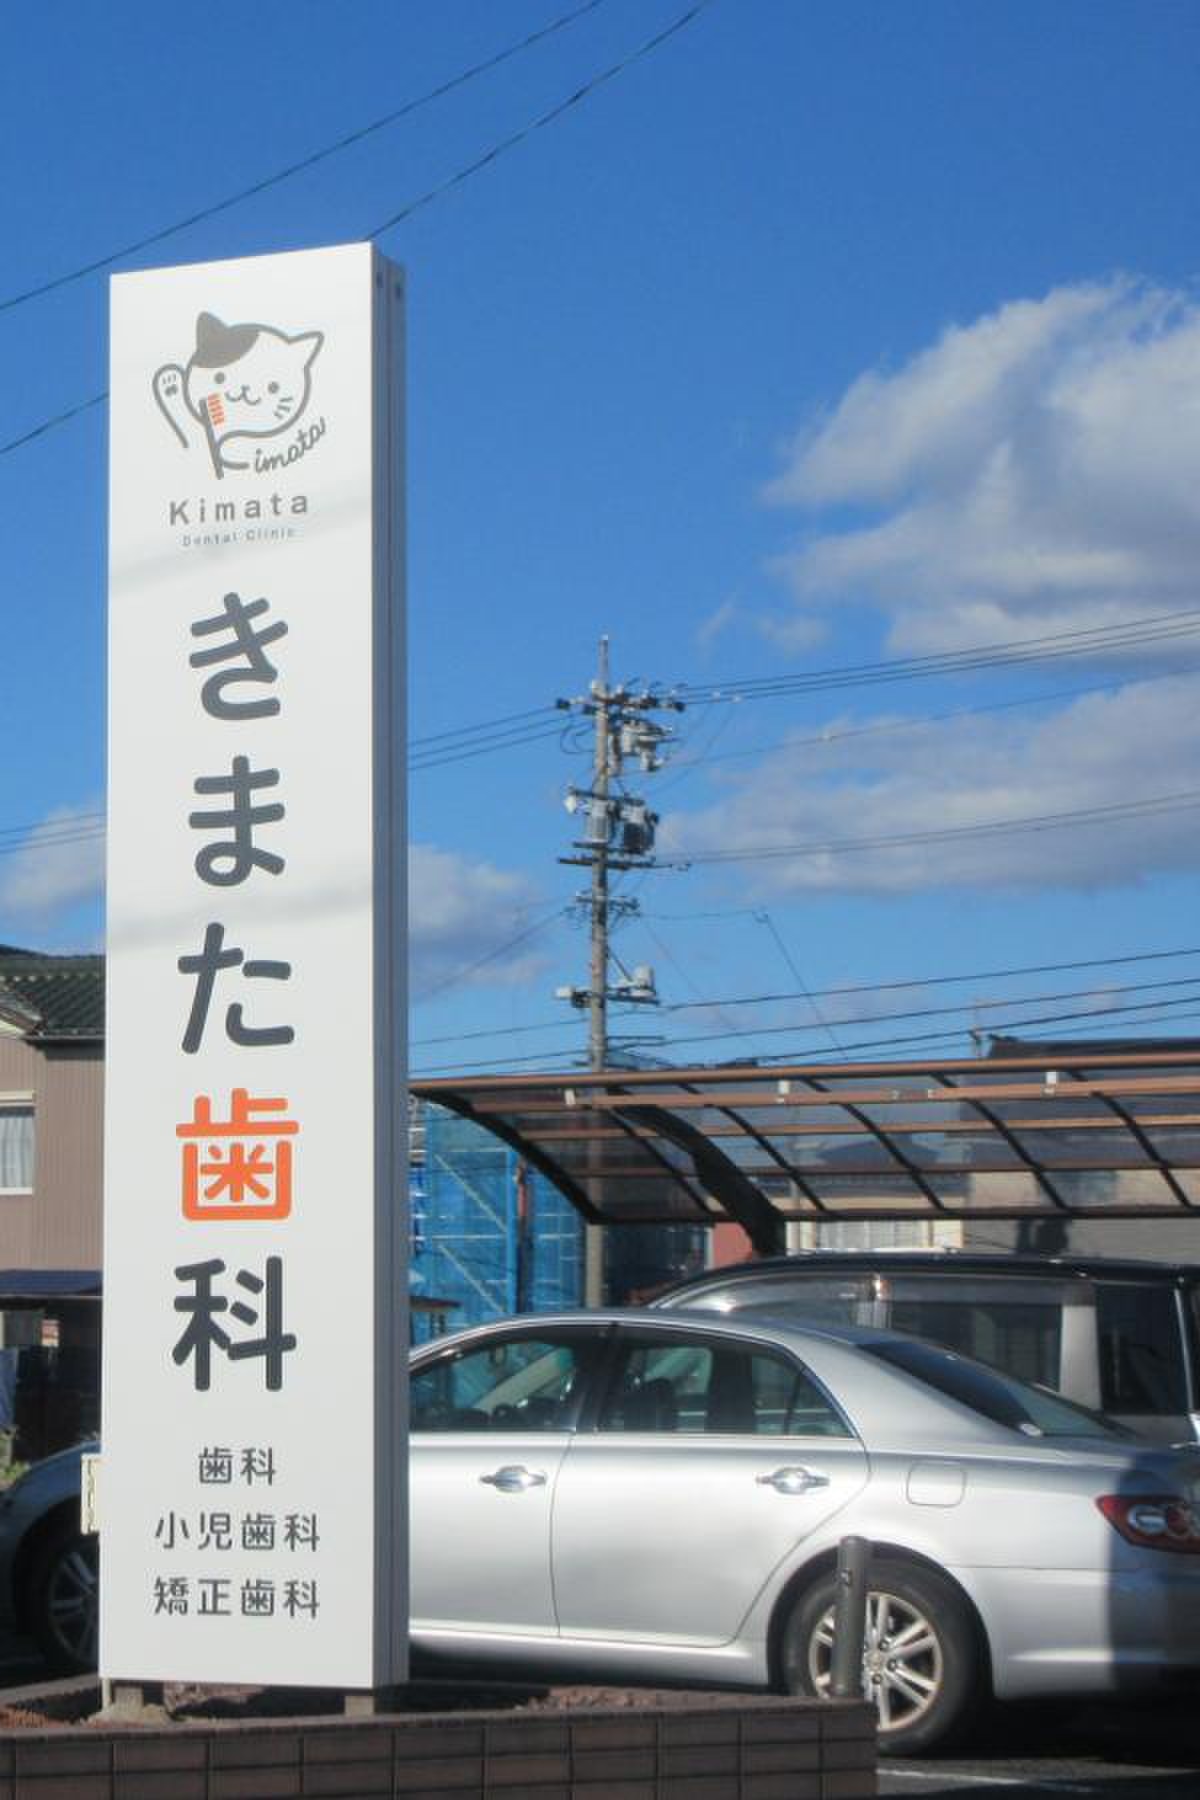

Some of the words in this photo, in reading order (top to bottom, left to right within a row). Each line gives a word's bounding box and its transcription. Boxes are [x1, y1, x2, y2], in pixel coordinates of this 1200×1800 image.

[169, 492, 309, 526] Kimata
[182, 530, 238, 546] Dental
[245, 527, 296, 543] Clinic
[171, 591, 300, 1393] きまた歯科
[198, 1446, 276, 1486] 歯科
[155, 1511, 321, 1553] 小児歯科
[153, 1576, 321, 1619] 矯正歯科
